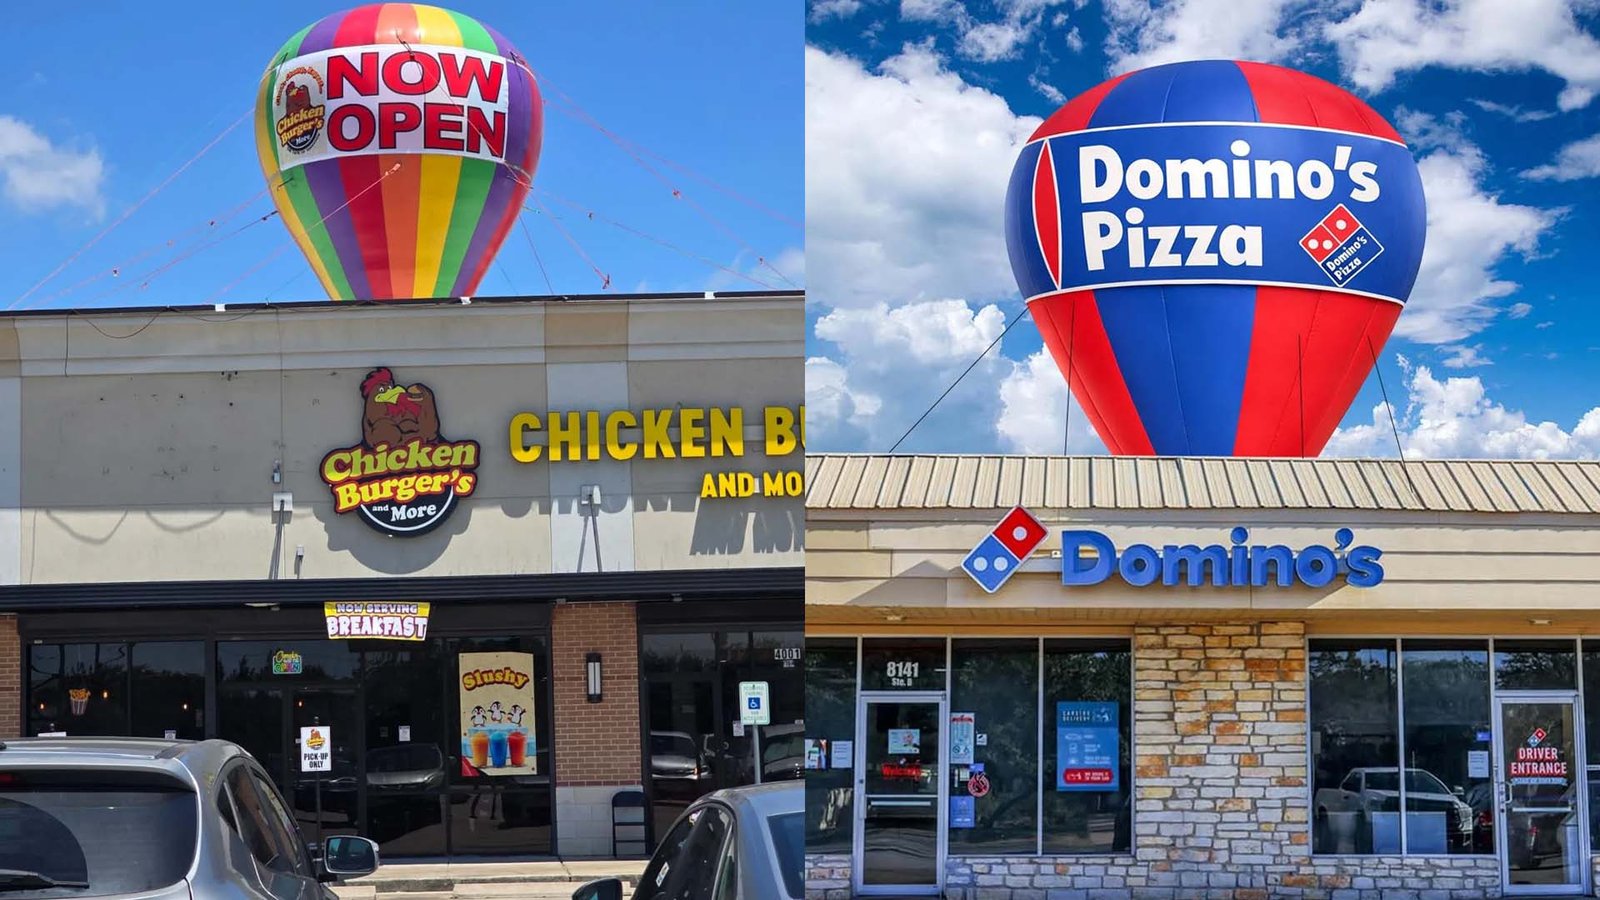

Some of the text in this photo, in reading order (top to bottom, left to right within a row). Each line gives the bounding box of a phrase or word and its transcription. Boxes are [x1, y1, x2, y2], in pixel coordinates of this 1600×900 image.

[327, 51, 504, 103] NOW
[277, 105, 325, 133] Chicken
[281, 118, 323, 145] Burger's
[327, 102, 506, 158] OPEN
[1079, 139, 1380, 204] Domino's
[1081, 207, 1263, 271] Pizza
[1326, 235, 1368, 272] Domino's
[1334, 257, 1362, 281] Pizza
[509, 405, 805, 463] CHICKEN B
[324, 440, 476, 482] Chicken
[335, 469, 473, 510] Burger's
[701, 472, 755, 498] AND
[372, 504, 437, 522] and More
[1061, 526, 1385, 588] Domino's
[336, 603, 418, 614] NOW SERVING
[326, 615, 428, 638] BREAKFAST
[775, 648, 800, 660] 4001
[462, 666, 530, 691] Slushy
[886, 661, 919, 678] 8141
[892, 677, 906, 686] Ste.
[303, 752, 329, 760] PICK-UP
[309, 760, 324, 768] ONLY
[1519, 747, 1558, 760] DRIVER
[1511, 762, 1567, 774] ENTRANCE
